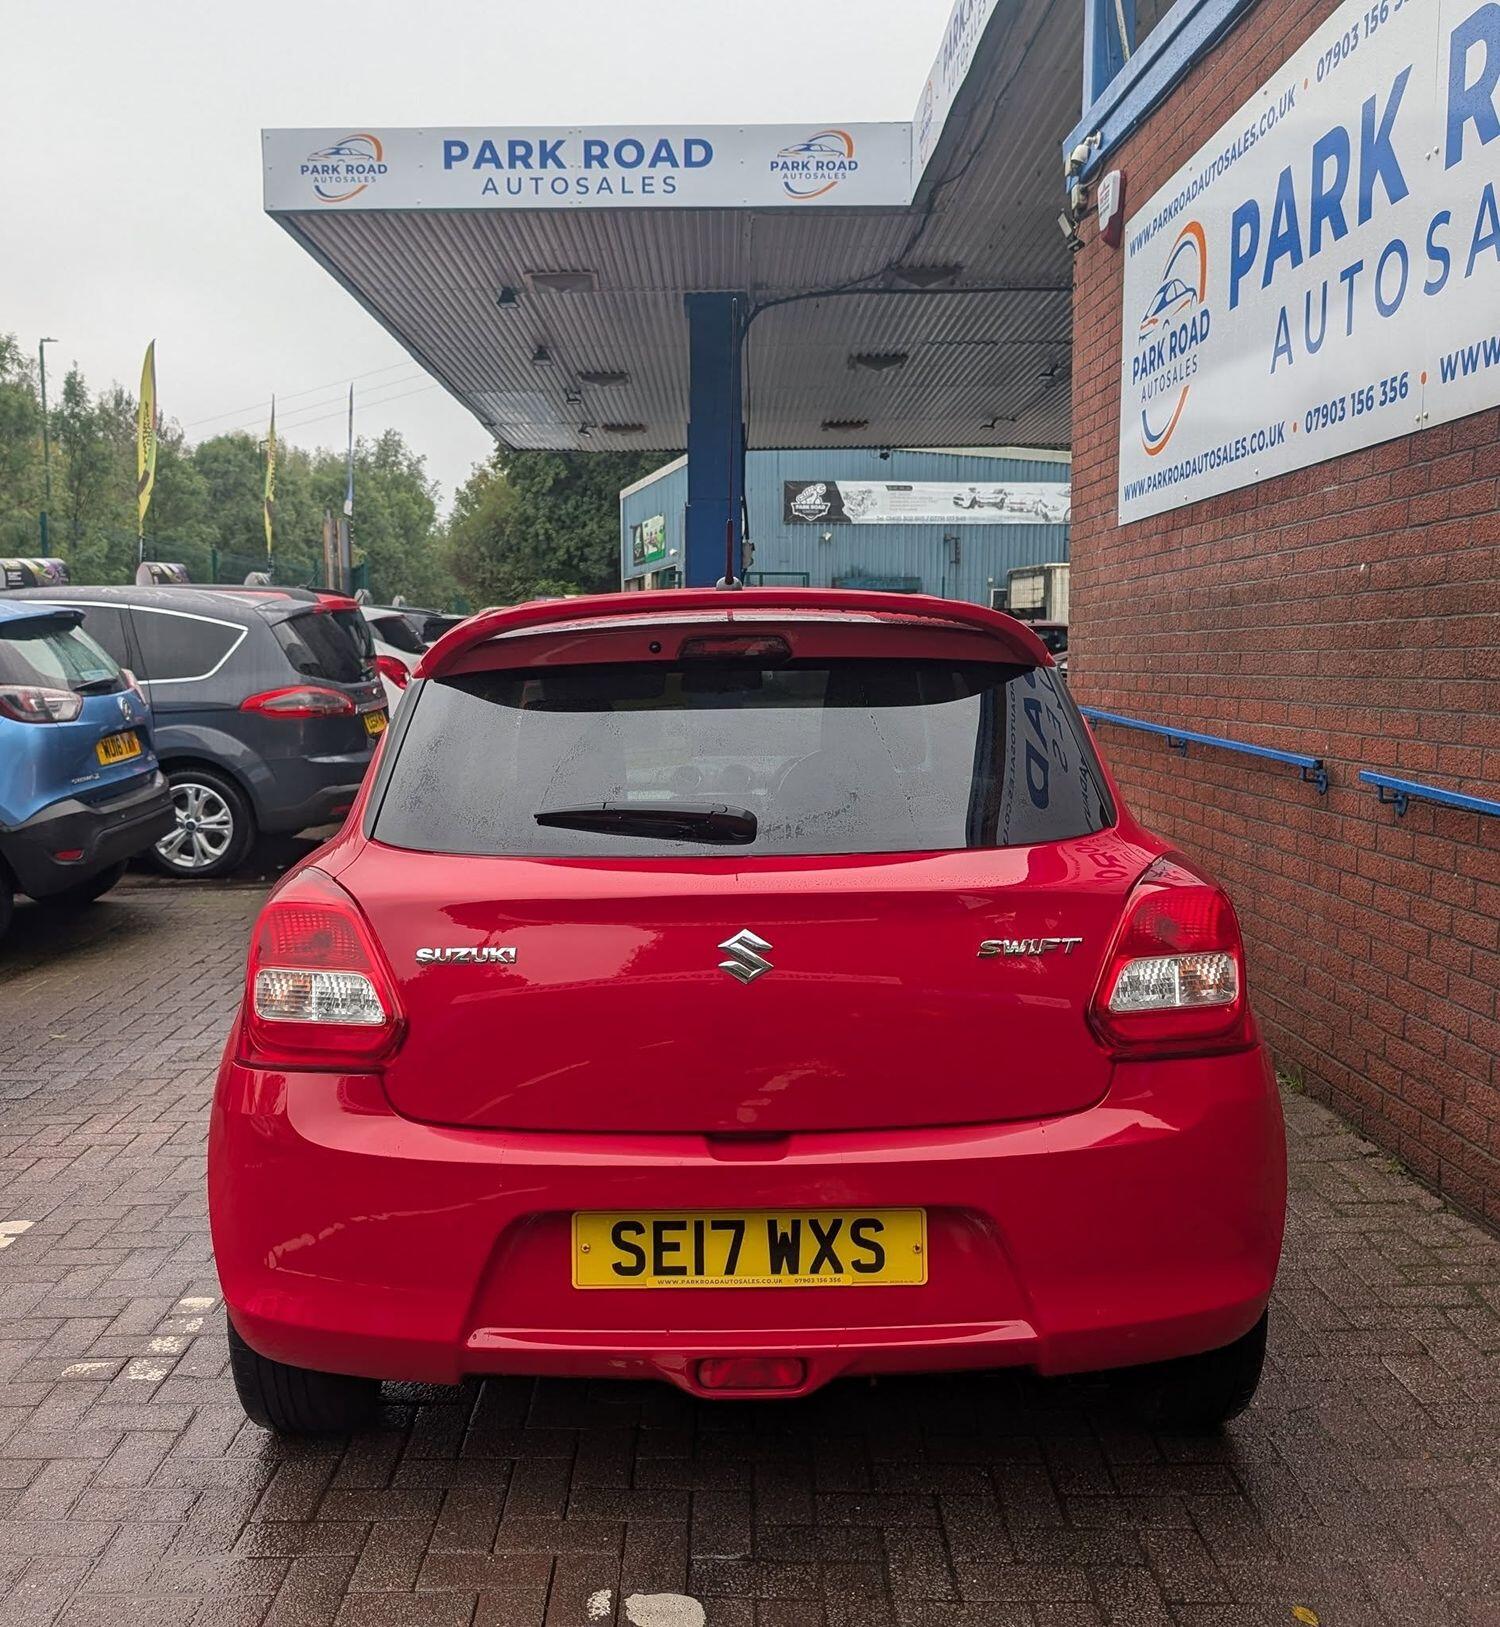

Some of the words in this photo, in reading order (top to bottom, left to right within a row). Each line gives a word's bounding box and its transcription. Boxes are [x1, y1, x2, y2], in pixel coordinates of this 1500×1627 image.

[1316, 22, 1360, 83] 07903
[1363, 0, 1389, 38] 156
[300, 164, 340, 176] PARK
[345, 163, 388, 176] ROAD
[443, 139, 567, 170] PARK
[583, 138, 714, 170] ROAD
[770, 160, 810, 172] PARK
[816, 160, 858, 172] ROAD
[313, 175, 377, 184] AUTOSALES
[482, 175, 677, 196] AUTOSALES
[782, 172, 847, 180] AUTOSALES
[1129, 84, 1296, 258] WWW.PARKROADAUTOSALES.CO.UK
[1229, 64, 1413, 311] PARK
[1132, 339, 1166, 386] PARK
[1169, 308, 1211, 361] ROAD
[1140, 356, 1198, 403] AUTOSALES
[1123, 421, 1285, 502] WWW.PARKROADAUTOSALES.CO.UK
[1304, 397, 1346, 434] 07903
[1351, 385, 1374, 418] 156
[1379, 371, 1409, 407] 356
[415, 947, 517, 965] SUZUKI
[977, 937, 1083, 958] SWIFT
[611, 1219, 746, 1277] SE17
[767, 1218, 885, 1276] WXS
